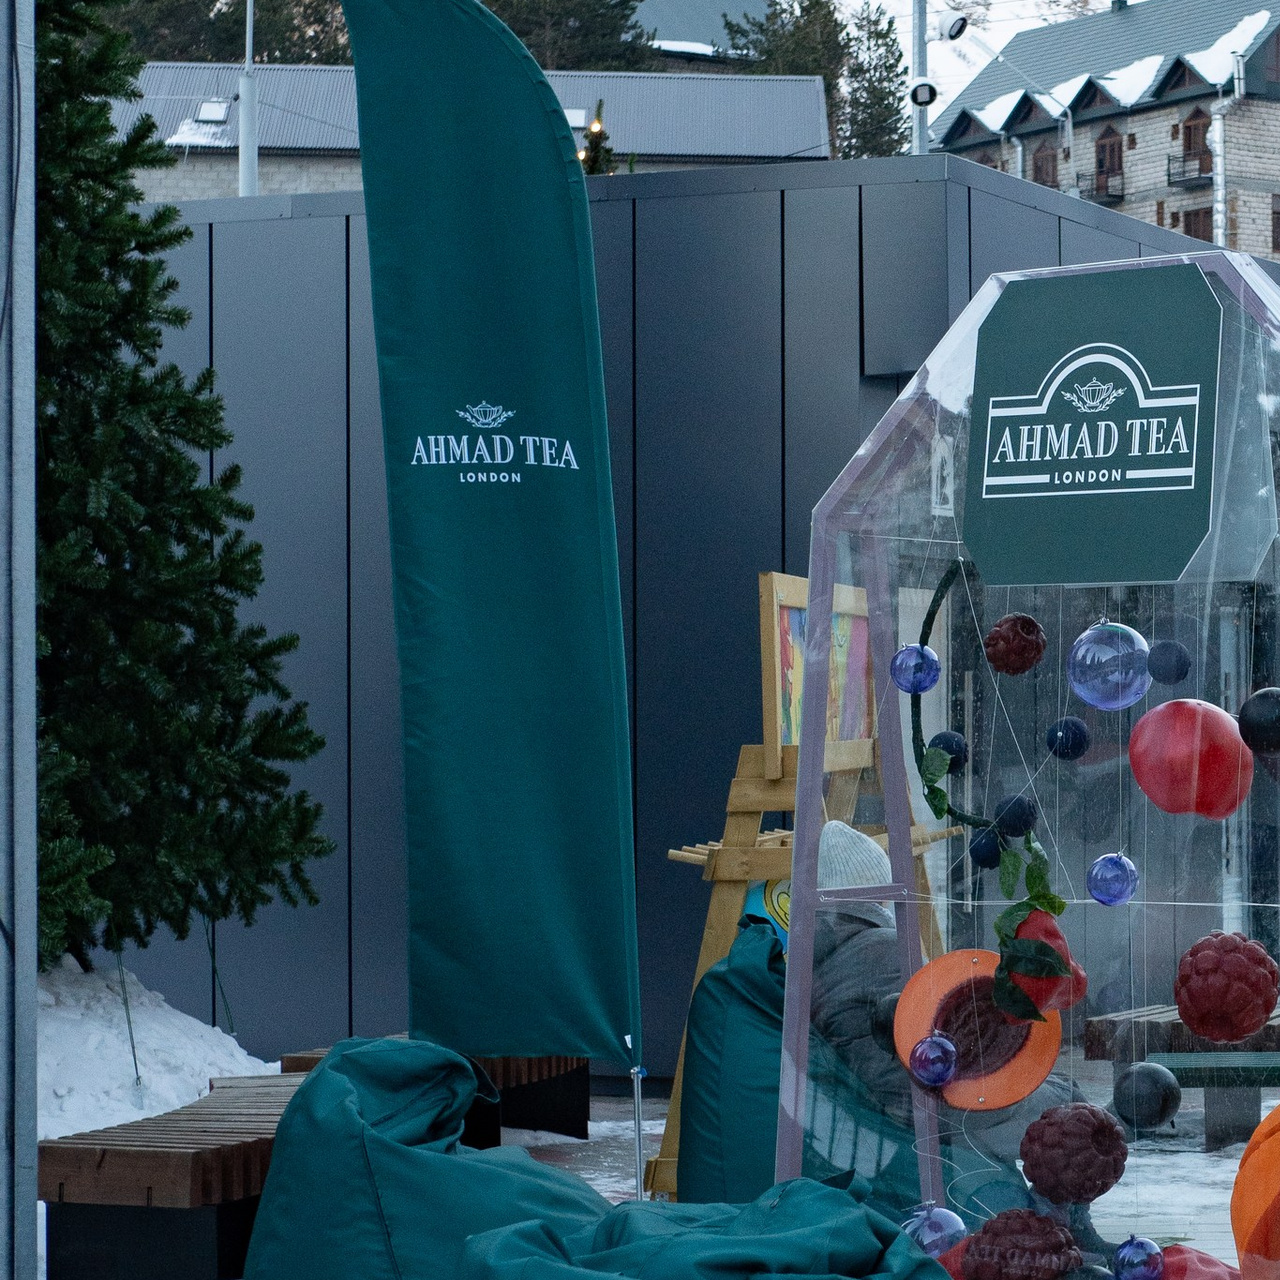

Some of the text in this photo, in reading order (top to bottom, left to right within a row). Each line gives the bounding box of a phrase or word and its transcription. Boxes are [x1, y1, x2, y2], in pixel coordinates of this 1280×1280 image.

[411, 434, 580, 470] AHMAD TEA
[993, 416, 1190, 463] AHMAD TEA
[459, 472, 521, 483] LONDON
[1054, 469, 1122, 484] LONDON
